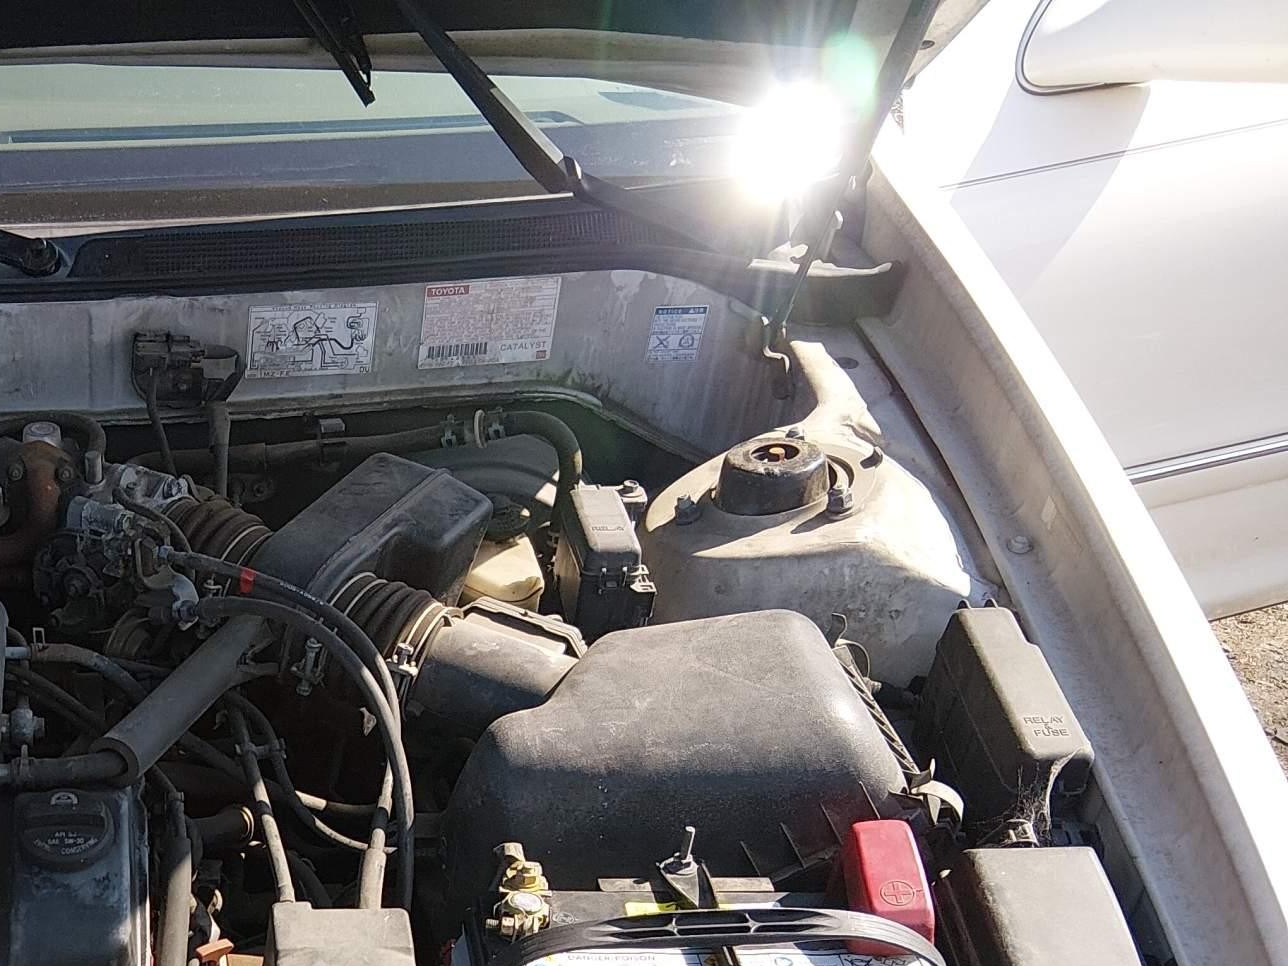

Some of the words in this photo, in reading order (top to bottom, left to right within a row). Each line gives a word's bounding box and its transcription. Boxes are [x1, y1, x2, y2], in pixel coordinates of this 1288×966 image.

[431, 287, 465, 296] TOYOTA
[500, 341, 547, 352] CATALYST
[1023, 716, 1064, 724] RELAY
[1033, 729, 1070, 737] FUSE
